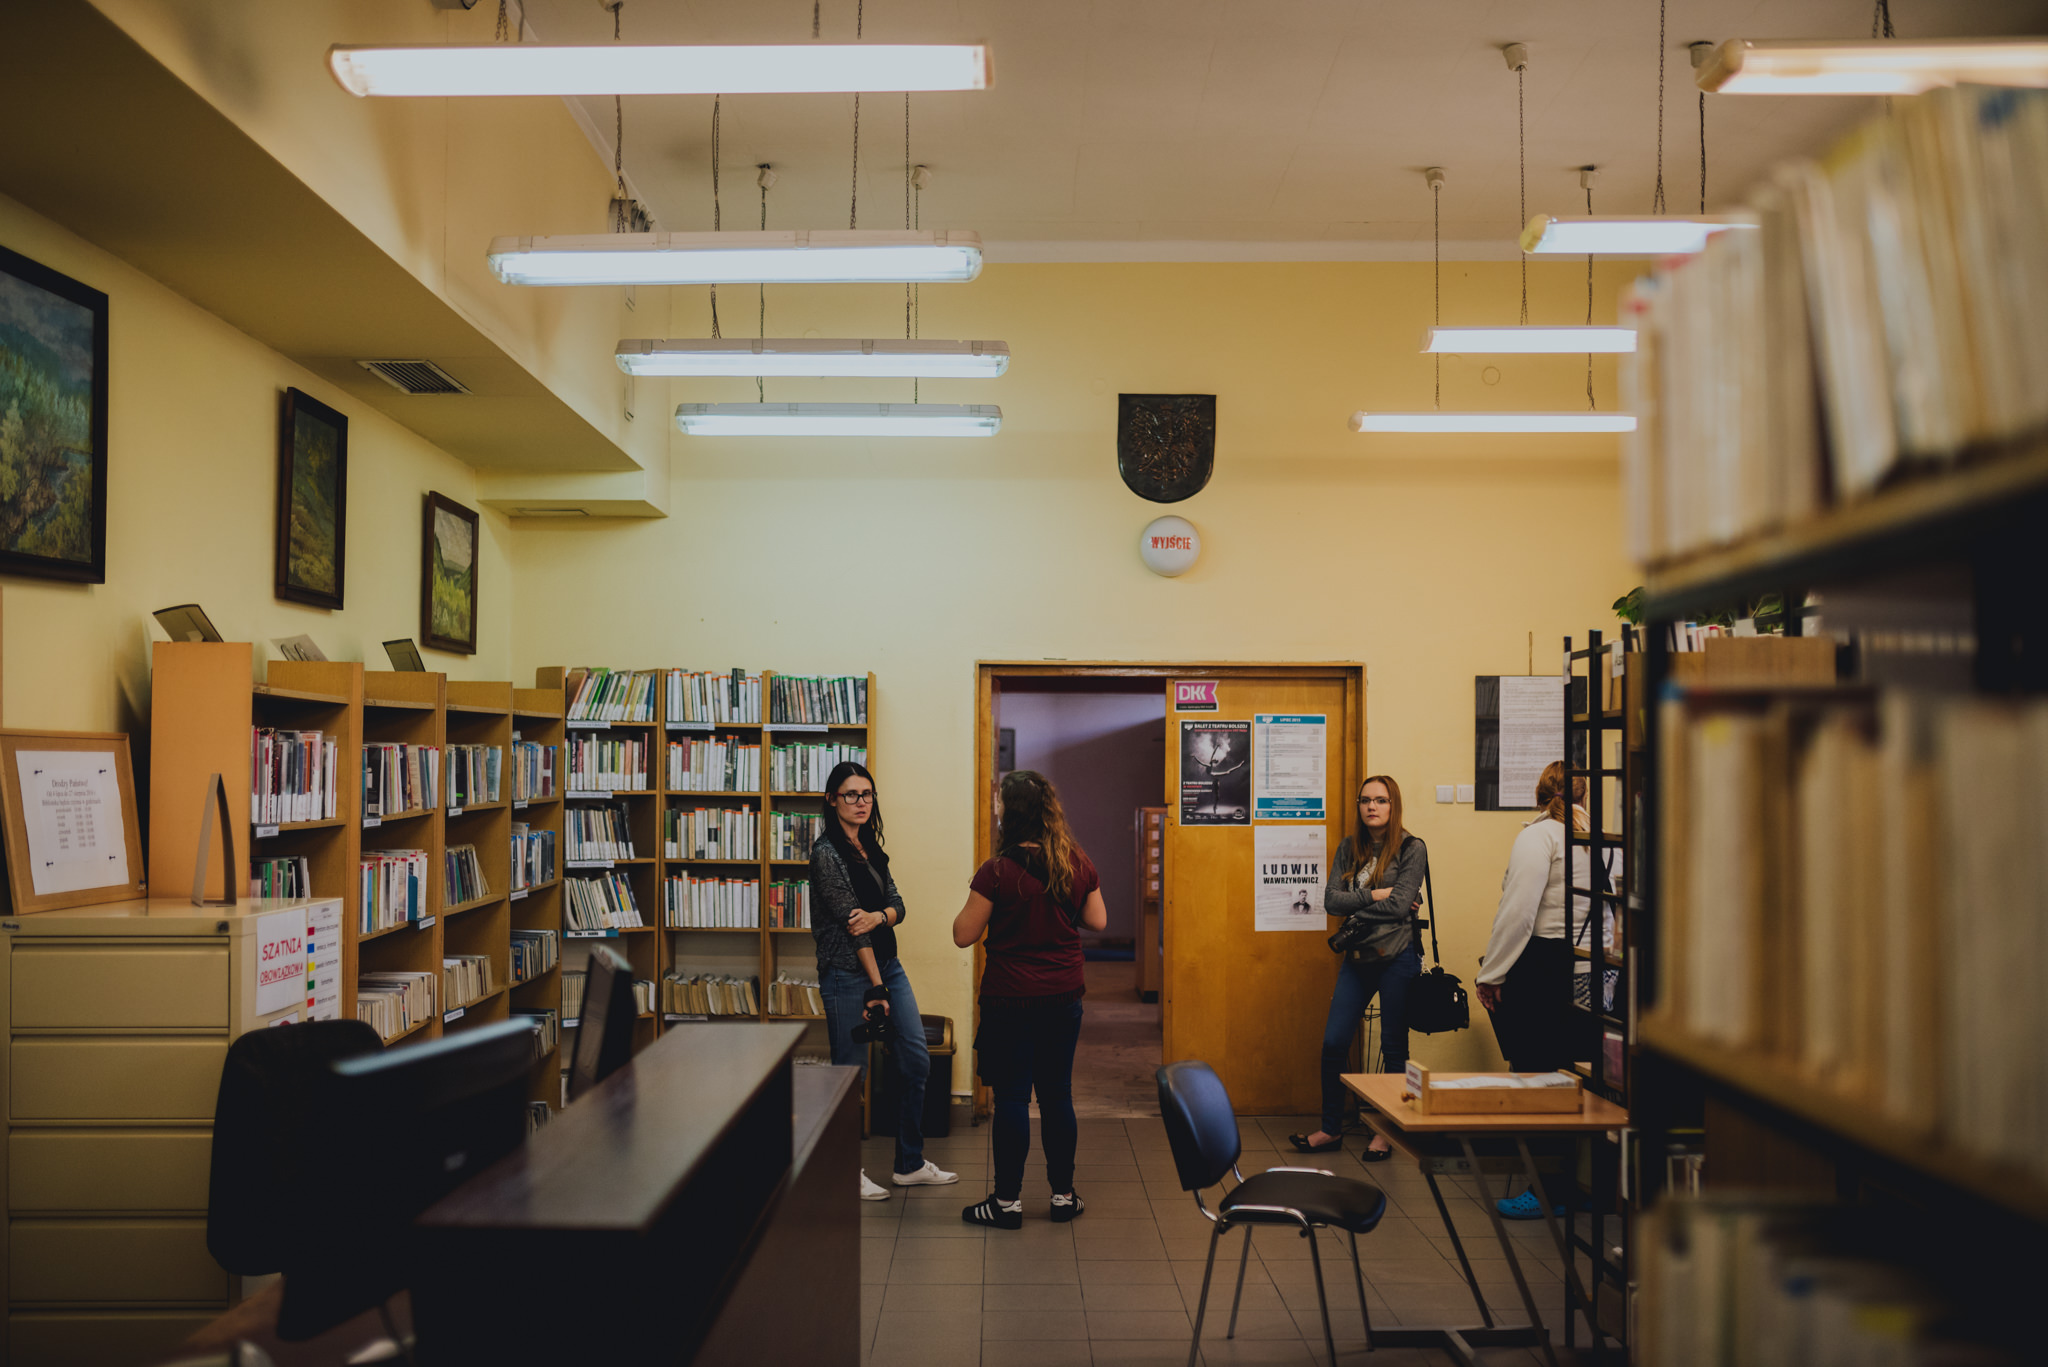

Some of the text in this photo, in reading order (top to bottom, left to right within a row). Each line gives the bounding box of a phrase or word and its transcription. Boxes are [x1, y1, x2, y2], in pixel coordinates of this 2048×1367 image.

[1151, 534, 1191, 550] WYJŚCIE
[1263, 864, 1318, 875] LUDWIK
[262, 937, 302, 961] SZATNIA
[260, 962, 303, 984] OBOWIĄZKOWA
